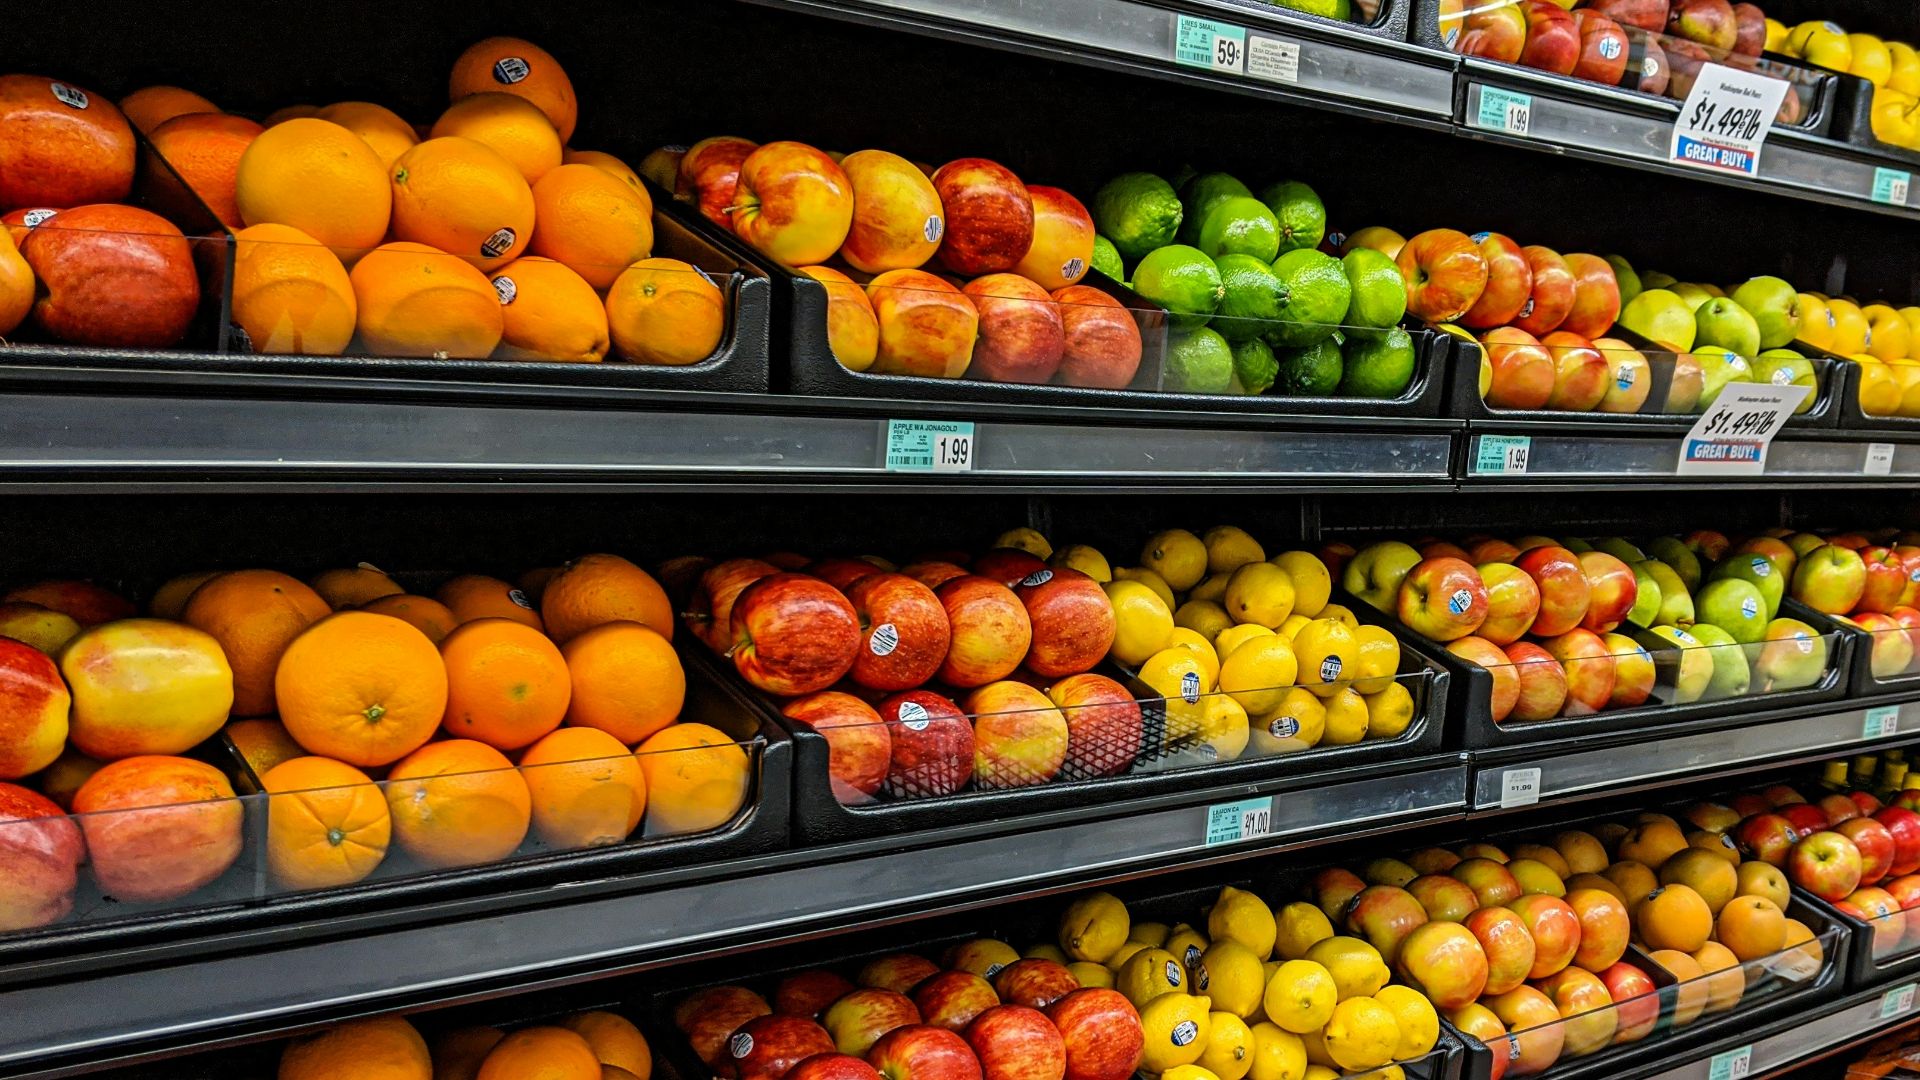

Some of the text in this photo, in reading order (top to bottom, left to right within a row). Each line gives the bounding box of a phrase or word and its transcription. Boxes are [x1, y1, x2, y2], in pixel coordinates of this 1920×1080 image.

[1181, 18, 1217, 32] LIMES SMALL
[1509, 107, 1527, 132] 1.99
[1689, 97, 1744, 136] $1.49
[1743, 108, 1762, 140] lb
[1684, 142, 1718, 162] GREAT
[1720, 149, 1747, 168] BUY!
[893, 423, 913, 431] APPLE
[924, 424, 958, 432] JONAGOLD
[1703, 409, 1760, 435] $1.49
[940, 437, 968, 465] 1.99
[1508, 448, 1526, 470] 1.99
[1694, 444, 1756, 459] GREAT BUY!
